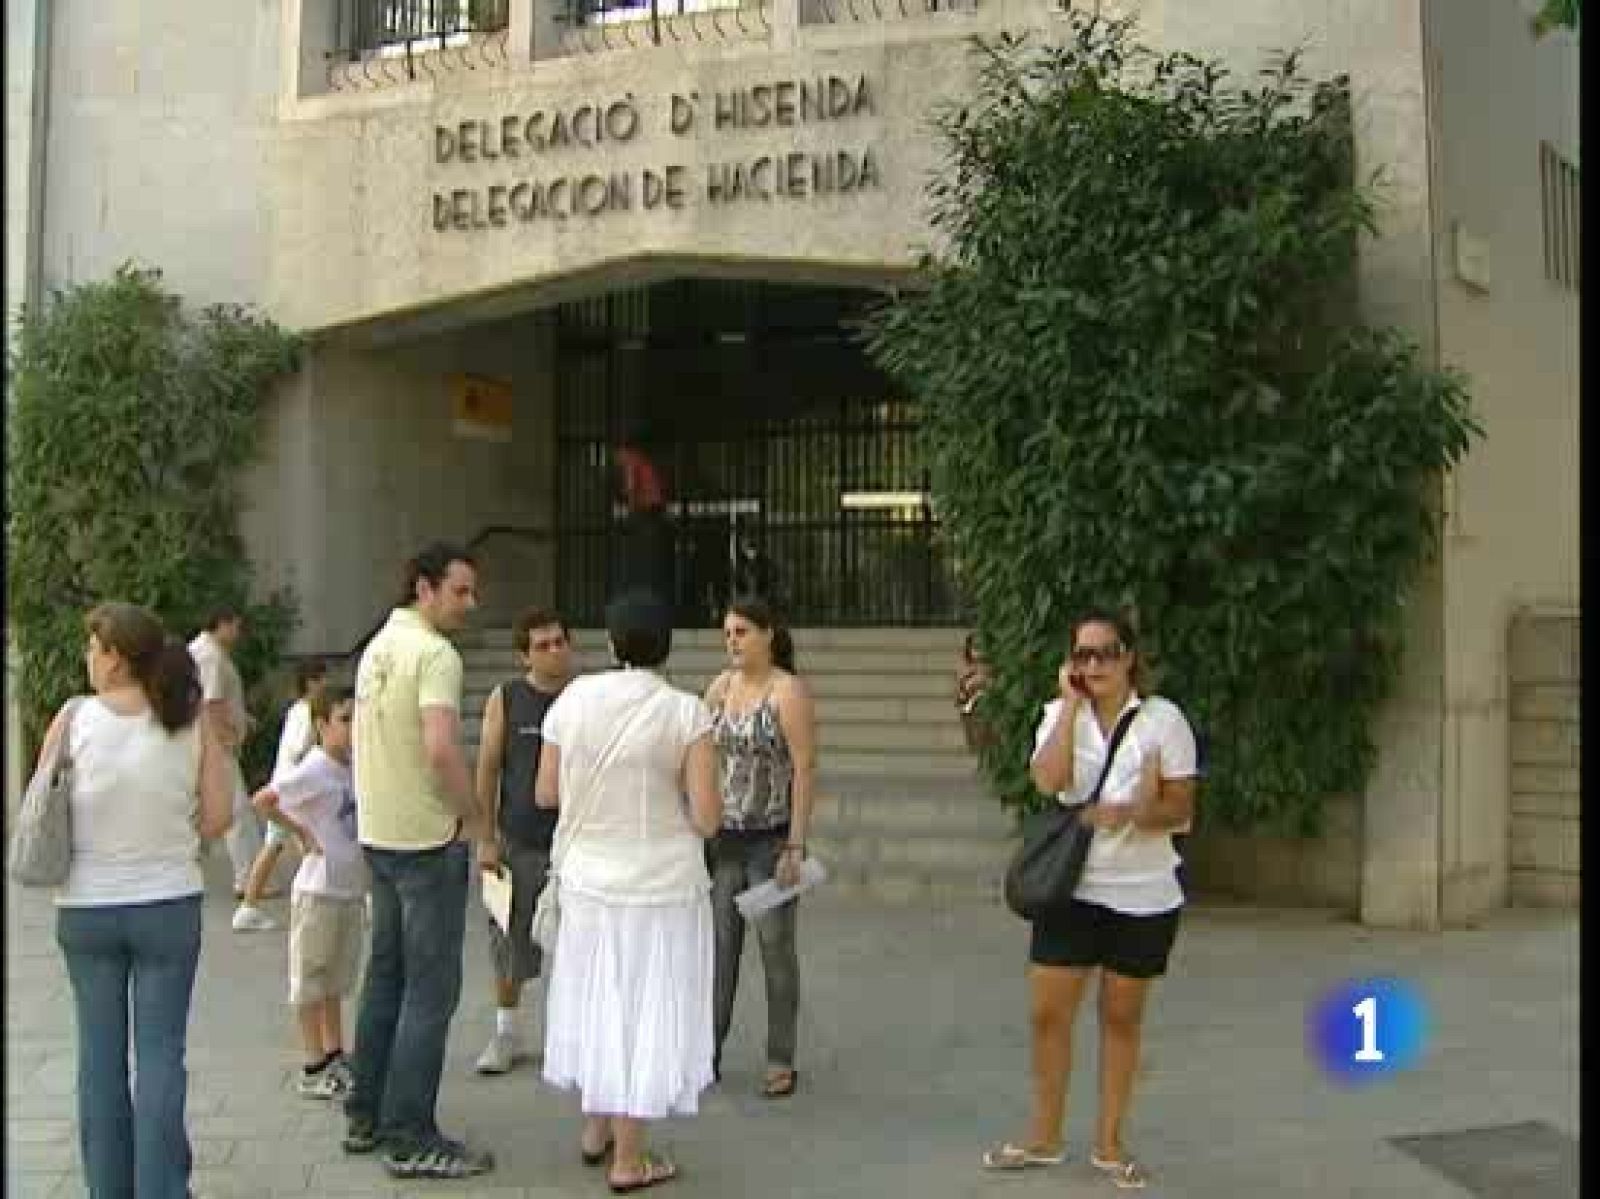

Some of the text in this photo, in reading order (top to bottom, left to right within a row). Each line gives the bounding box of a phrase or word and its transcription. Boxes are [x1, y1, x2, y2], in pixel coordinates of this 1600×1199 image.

[434, 91, 640, 164] DELEGACIÓ
[715, 73, 876, 130] HISENDA
[432, 146, 881, 232] DELEGACION DE HACIENDA
